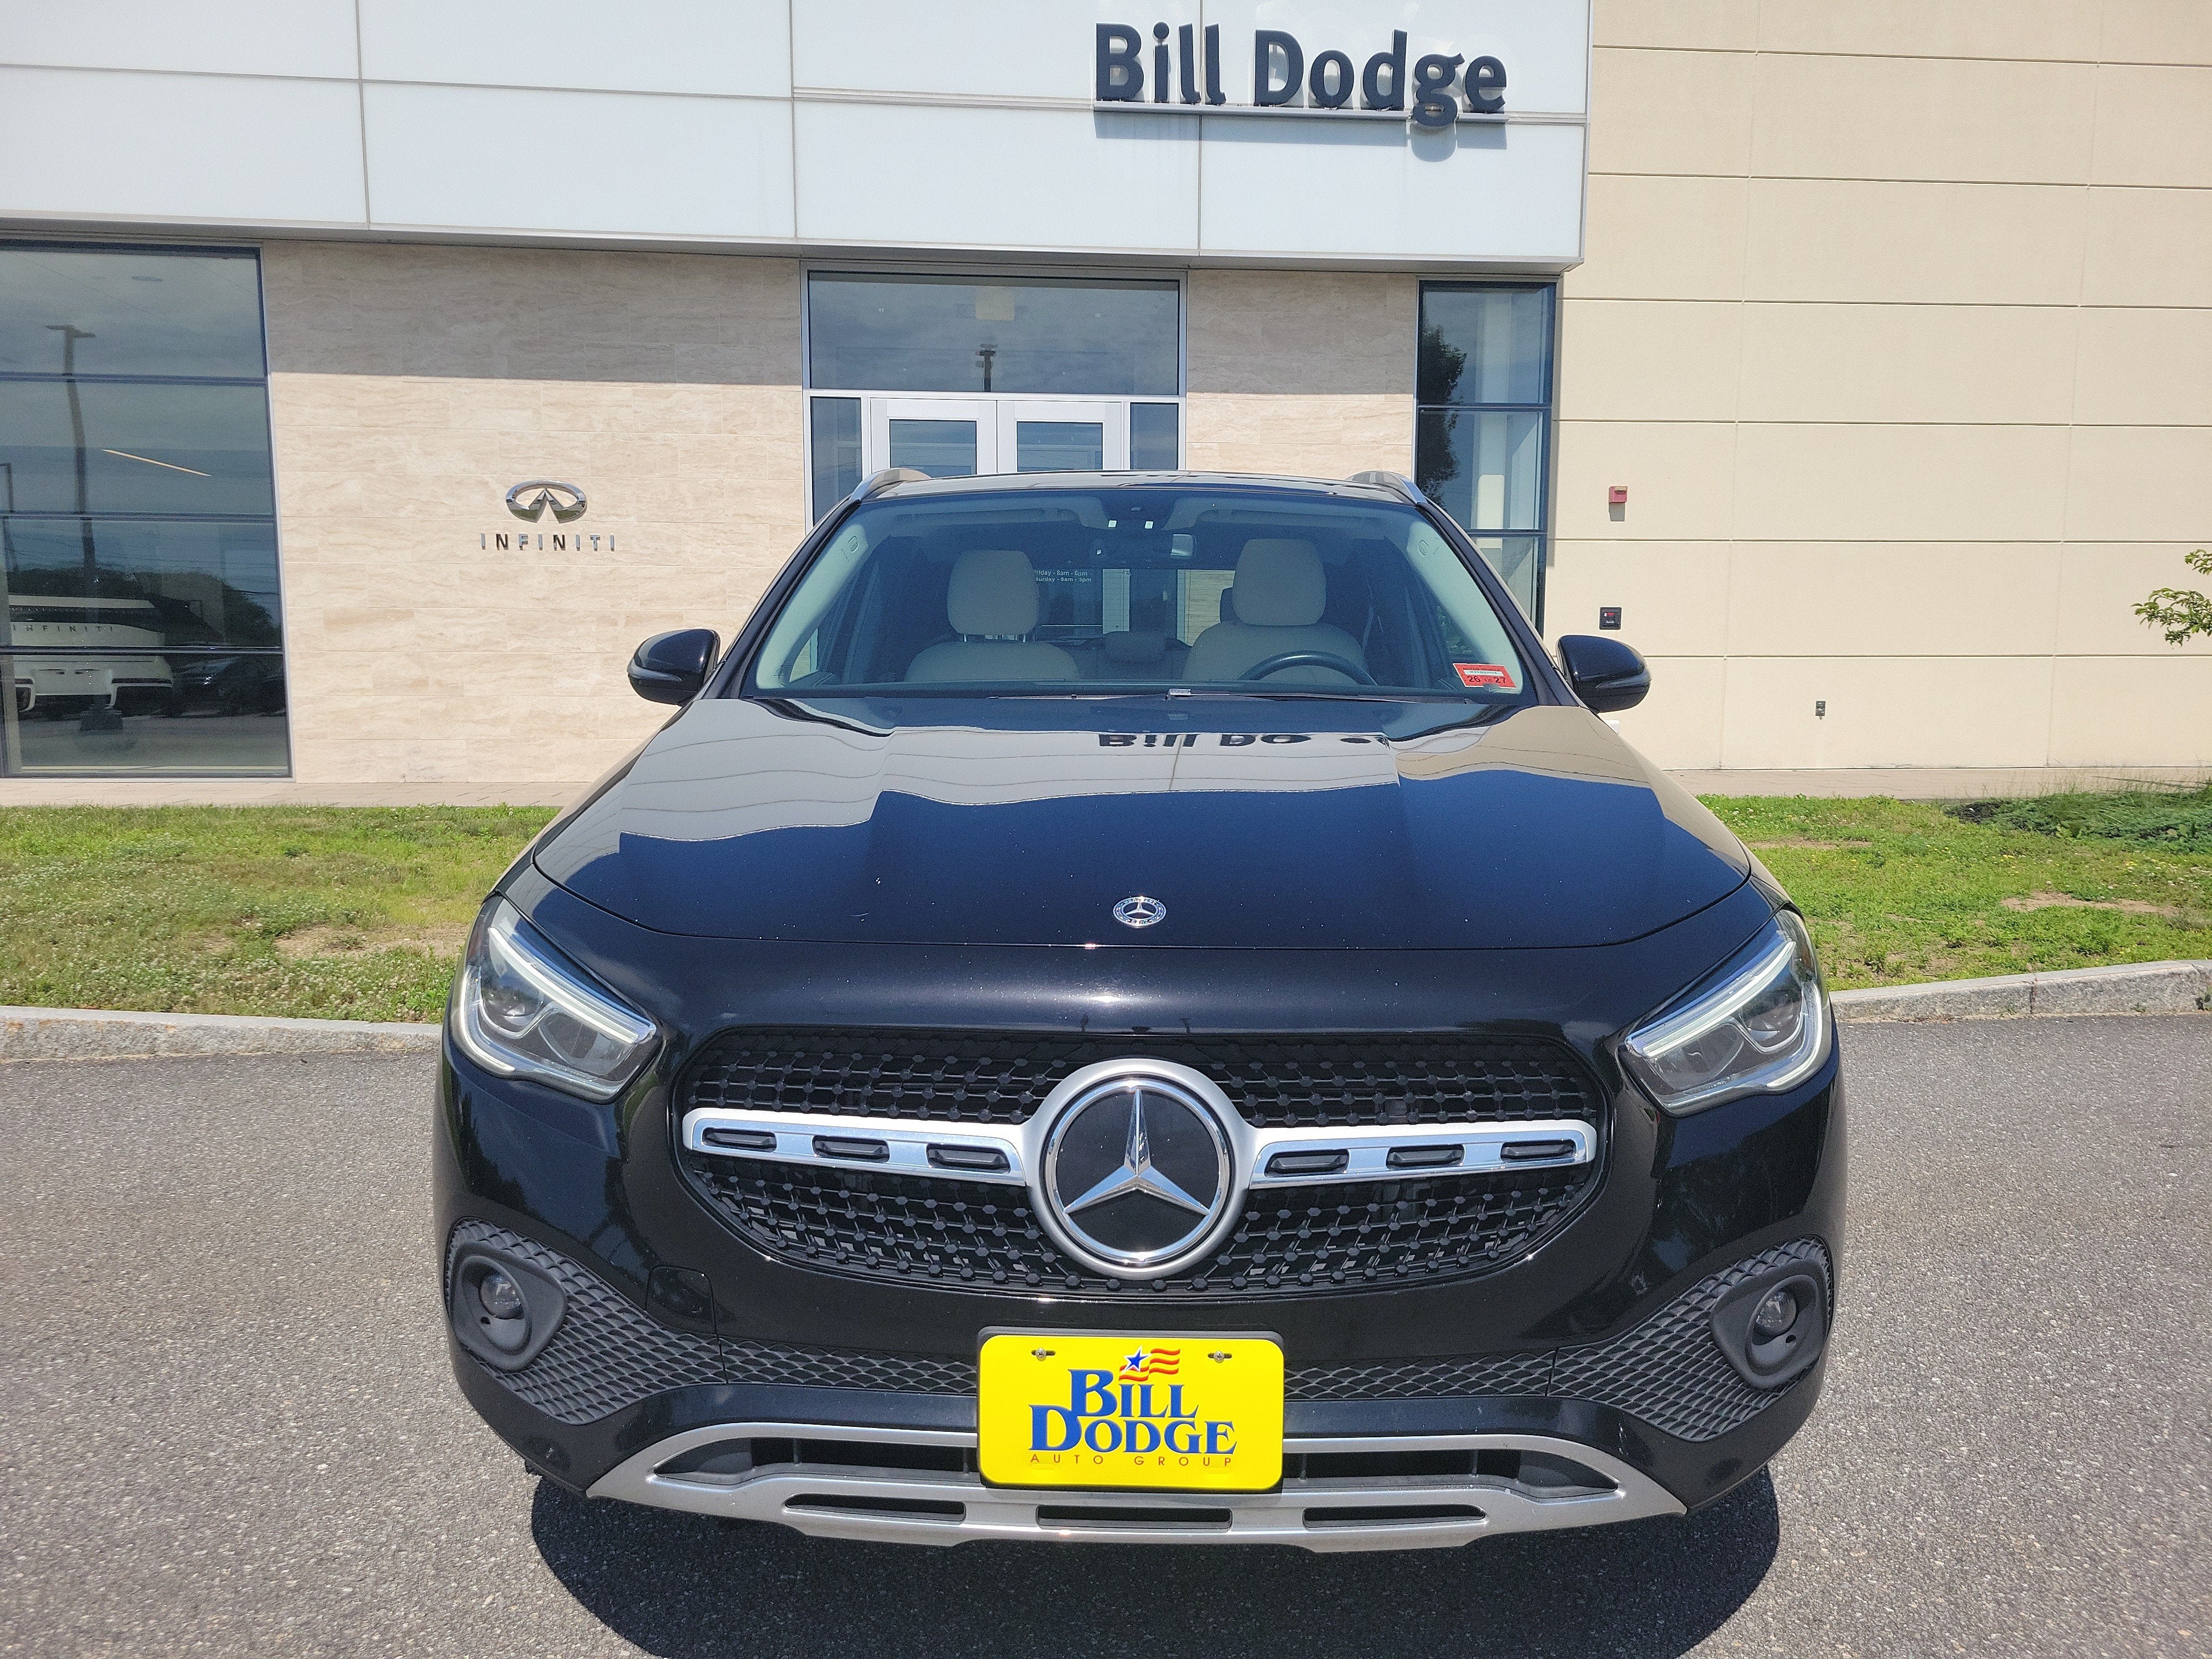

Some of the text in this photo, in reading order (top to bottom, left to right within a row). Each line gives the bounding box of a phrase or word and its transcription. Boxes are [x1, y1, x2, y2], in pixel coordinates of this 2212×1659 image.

[1096, 21, 1506, 127] Bill Dodge
[480, 533, 615, 551] INFINITI
[1067, 1369, 1199, 1418] BILL
[1029, 1404, 1238, 1454] DODGE
[1030, 1454, 1232, 1466] AUTO GROUP
